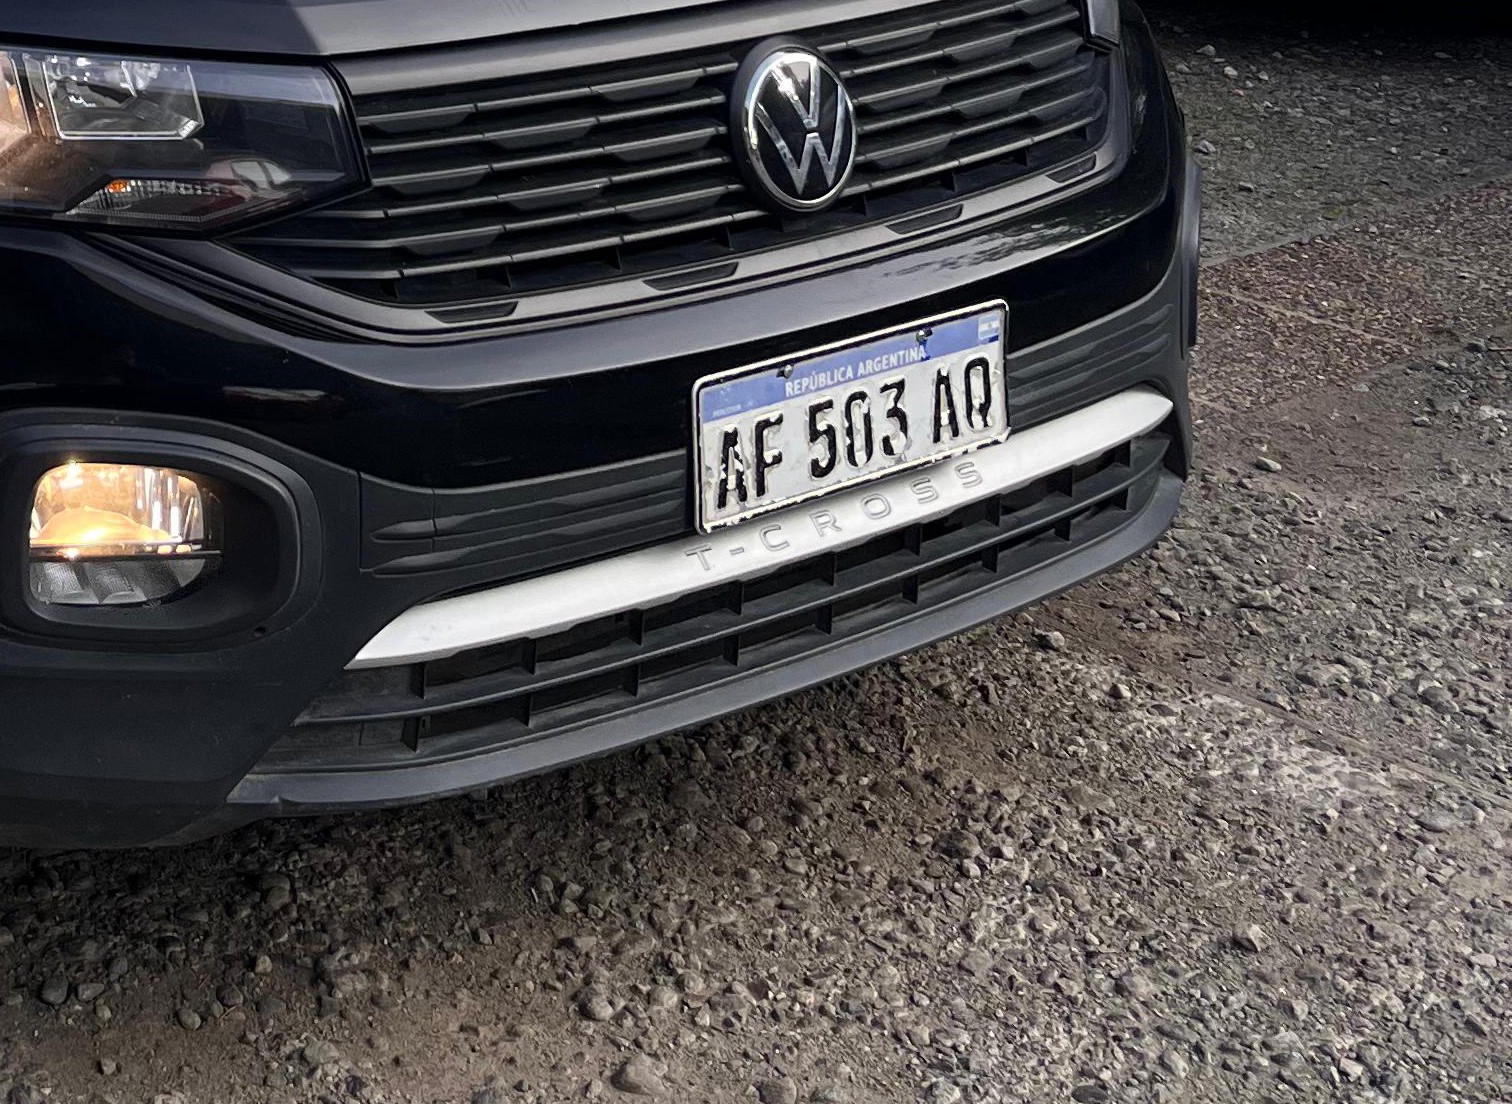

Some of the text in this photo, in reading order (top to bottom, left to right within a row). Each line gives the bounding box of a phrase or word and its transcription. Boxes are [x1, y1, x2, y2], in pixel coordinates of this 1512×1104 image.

[748, 52, 853, 203] VW
[717, 356, 991, 510] AF 503 AQ
[785, 345, 927, 398] REPÚBLICA ARGENTINA
[685, 461, 984, 571] T-CROSS
